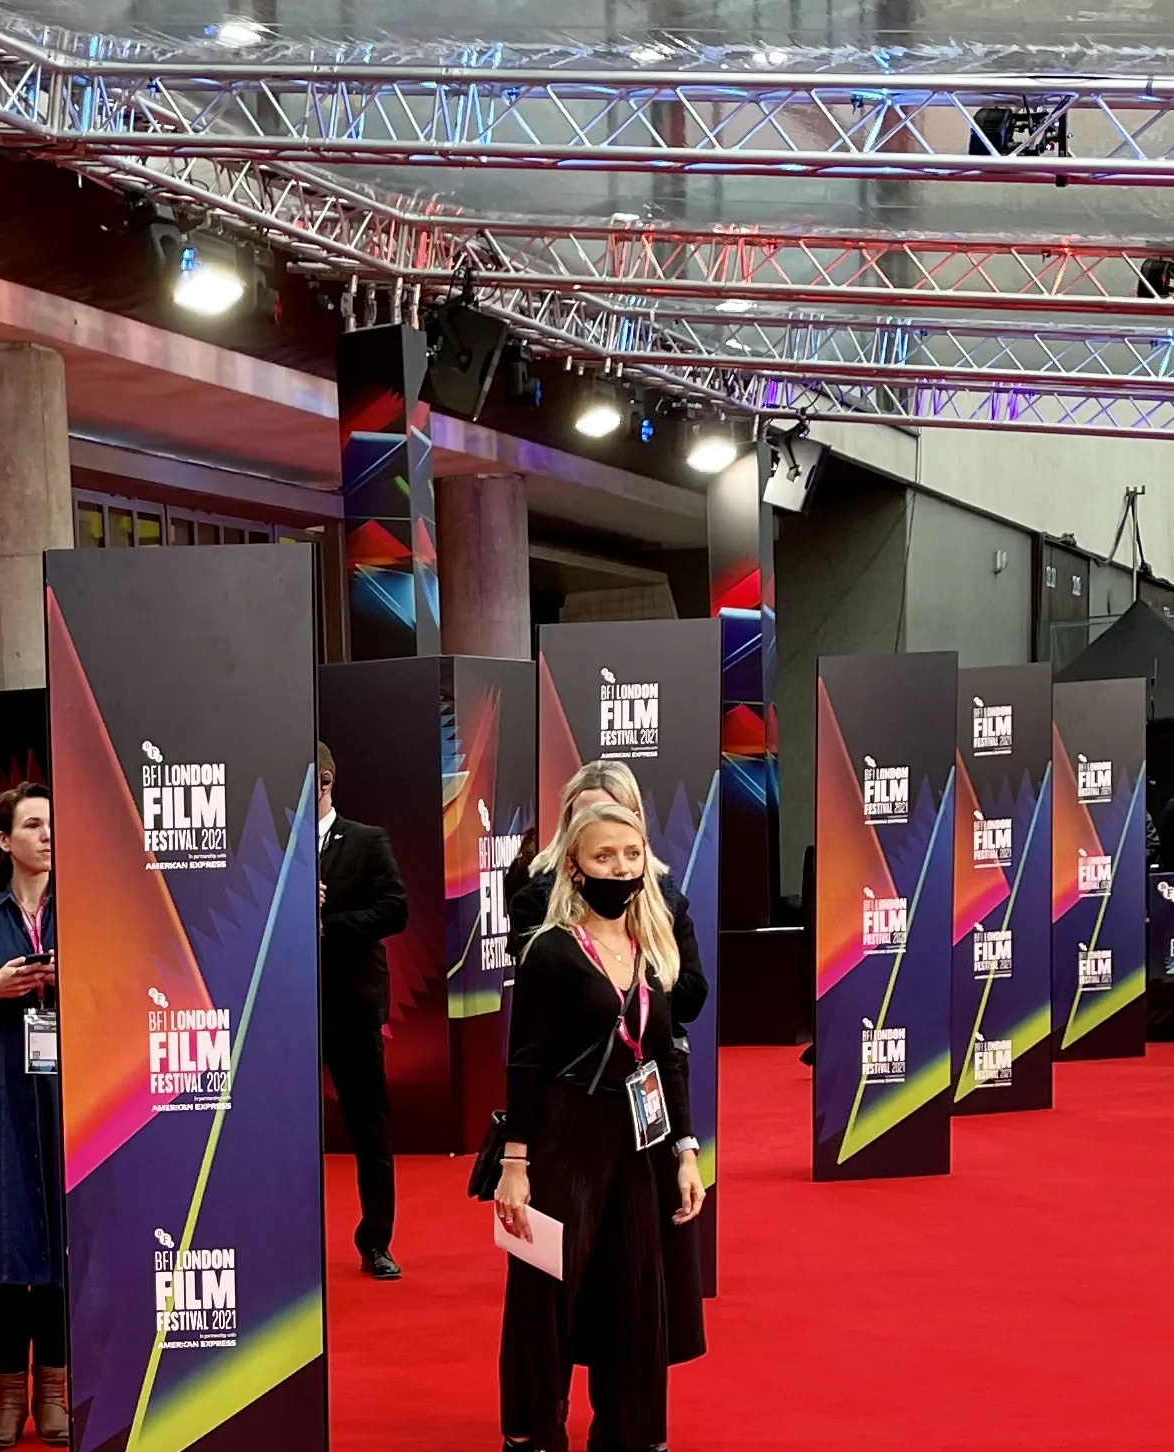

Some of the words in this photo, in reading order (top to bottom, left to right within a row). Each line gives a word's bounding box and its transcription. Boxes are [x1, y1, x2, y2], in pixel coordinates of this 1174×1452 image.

[601, 685, 614, 700] BFI
[616, 683, 658, 699] LONDON
[601, 699, 658, 730] FILM
[601, 730, 638, 746] FESTIVAL
[640, 729, 658, 744] 2021
[974, 716, 1012, 738] FILM
[143, 765, 161, 787] BFI
[165, 763, 225, 786] LONDON
[1078, 770, 1111, 788] FILM
[864, 779, 909, 803] FILM
[143, 786, 226, 829] FILM
[144, 829, 198, 851] FESTIVAL
[201, 828, 226, 850] 2021
[974, 828, 1012, 850] FILM
[145, 862, 188, 870] AMERICAN
[1078, 864, 1111, 882] FILM
[480, 870, 511, 936] FIL
[863, 910, 907, 934] FILM
[974, 940, 1012, 962] FILM
[1079, 959, 1111, 976] FILM
[149, 1011, 167, 1031] BFI
[171, 1009, 230, 1030] LONDON
[149, 1030, 231, 1073] FILM
[862, 1040, 905, 1063] FILM
[975, 1049, 1012, 1070] FILM
[151, 1073, 203, 1094] FESTIVAL
[207, 1072, 231, 1092] 2021
[154, 1251, 173, 1270] BFI
[176, 1249, 235, 1270] LONDON
[155, 1270, 236, 1311] FILM
[156, 1311, 209, 1331] FESTIVAL
[212, 1310, 236, 1329] 2021
